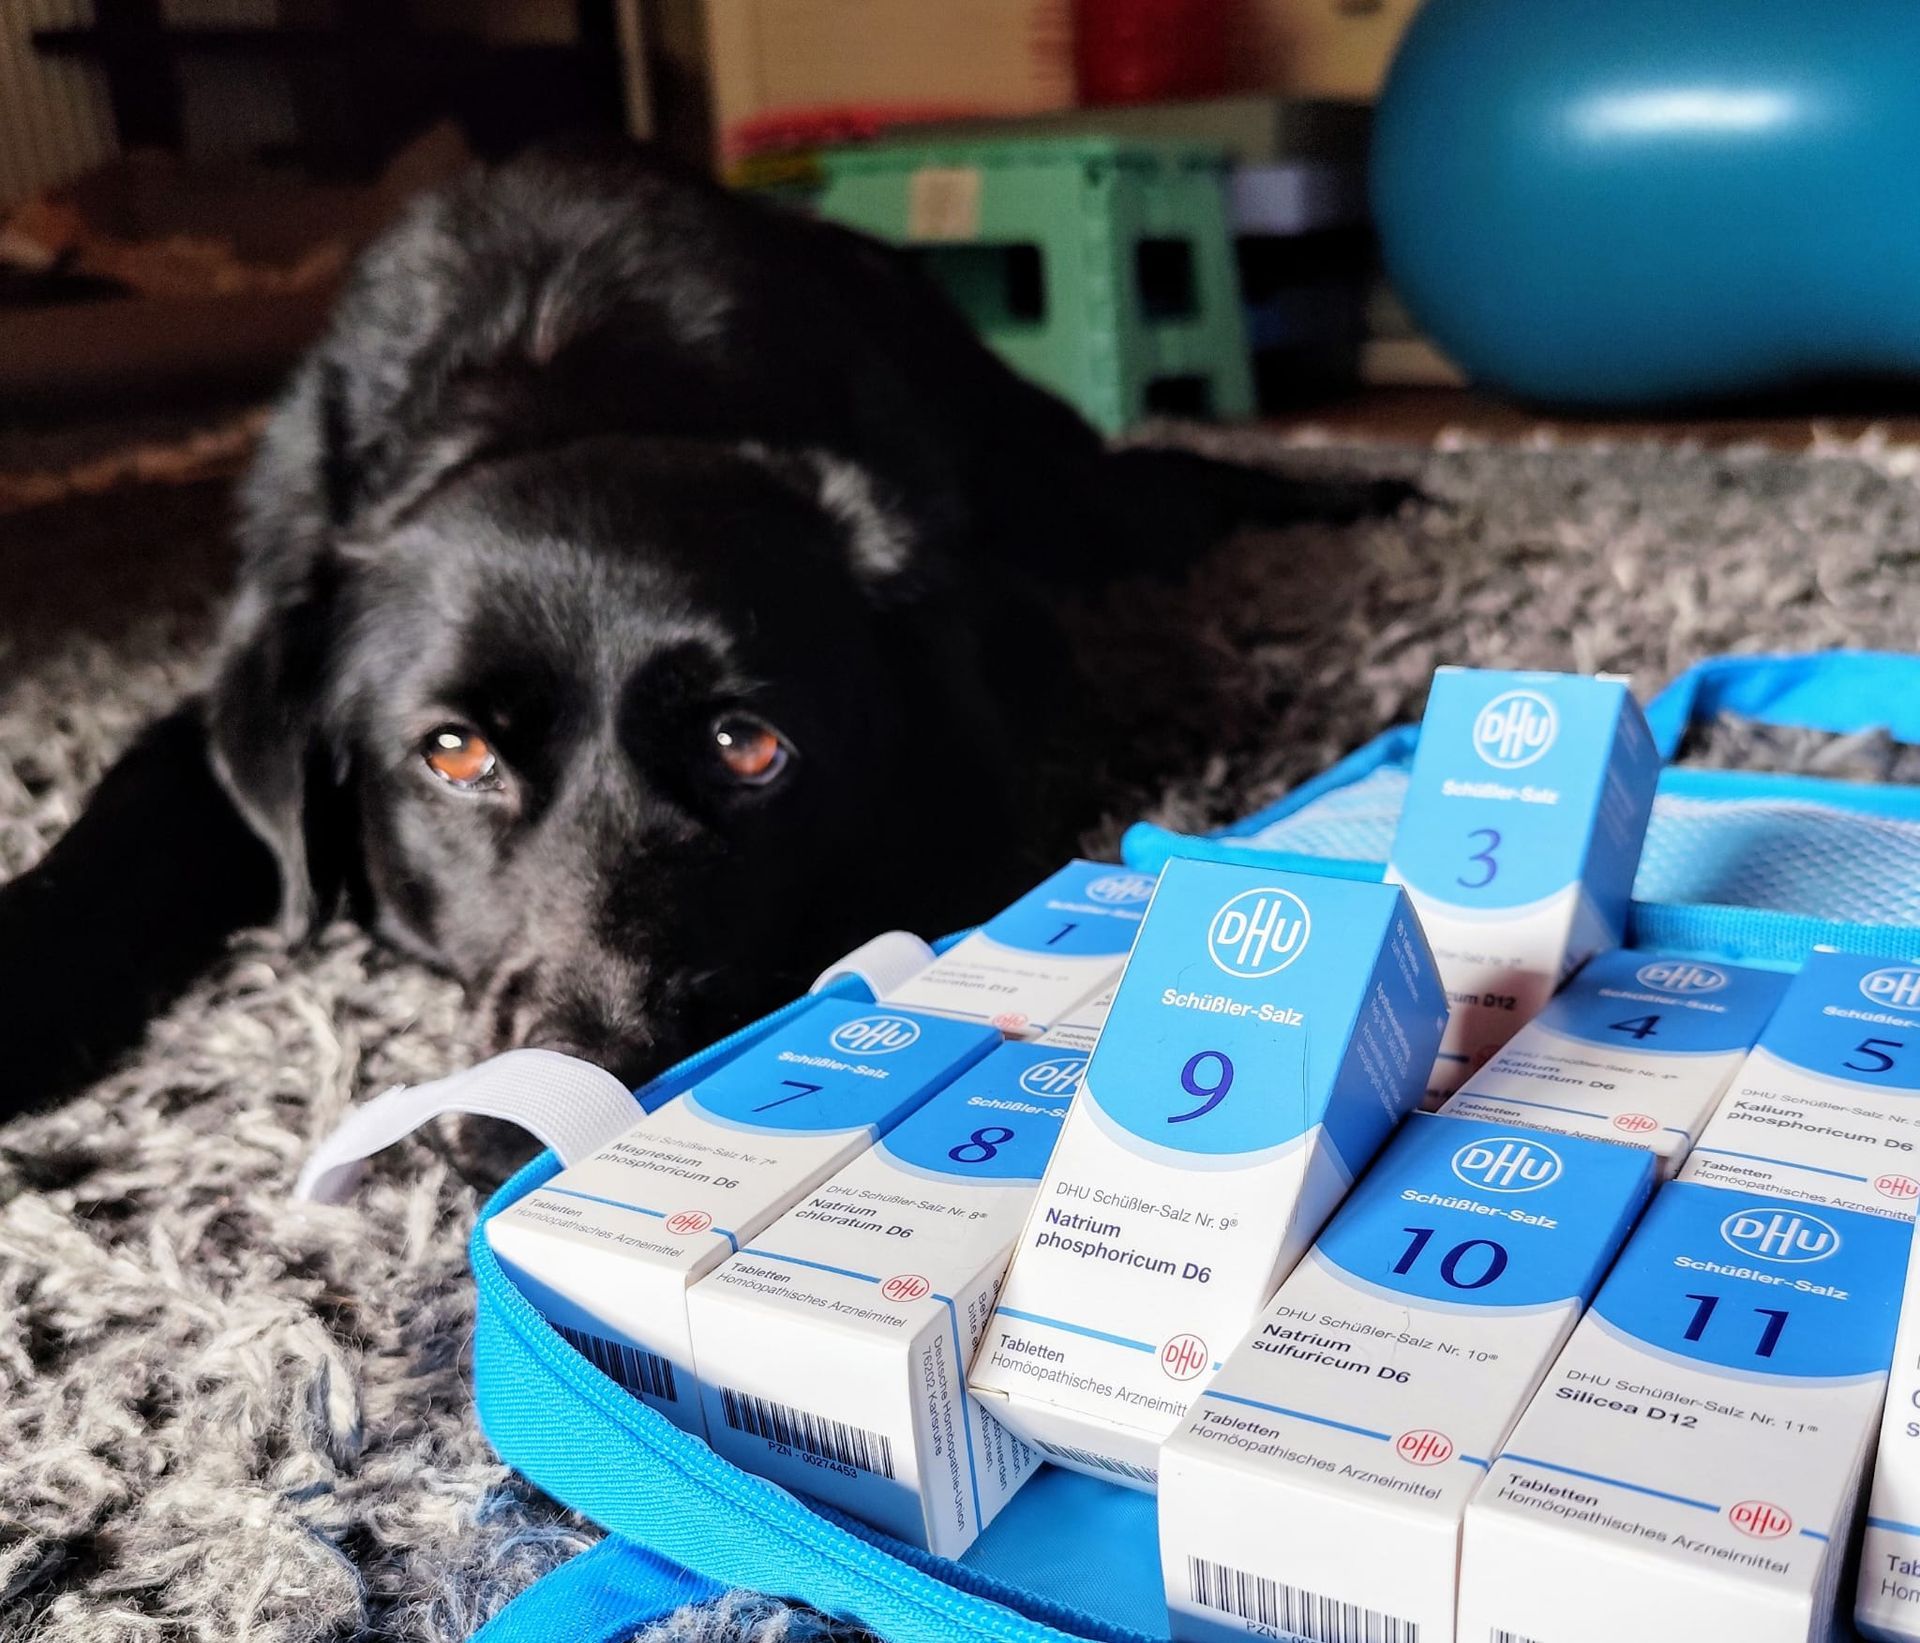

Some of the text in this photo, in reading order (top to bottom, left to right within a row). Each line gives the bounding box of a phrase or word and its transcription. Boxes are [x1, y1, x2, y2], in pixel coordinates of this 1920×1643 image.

[1481, 700, 1548, 759] DHU
[1456, 828, 1502, 889] 3
[1046, 922, 1080, 945] 1
[1216, 898, 1302, 967] DHU
[1647, 962, 1718, 990] DHU
[1868, 973, 1920, 1006] DH
[1161, 988, 1304, 1027] Schüßler-Salz
[1483, 993, 1517, 1011] D12
[839, 1020, 913, 1050] DHU
[1608, 1015, 1662, 1040] 4
[778, 1051, 890, 1079] Schüßler-Salz
[1498, 1058, 1561, 1073] Kalium
[1842, 1038, 1904, 1073] 5
[1028, 1062, 1084, 1093] DH
[1167, 1050, 1234, 1123] 9
[1491, 1066, 1616, 1091] chloratum D6
[751, 1080, 824, 1112] 7
[1457, 1101, 1521, 1117] Tabletten
[1734, 1100, 1804, 1119] Kalium
[1741, 1088, 1776, 1099] DHU
[1780, 1093, 1884, 1120] Schüßler-Salz
[1888, 1114, 1909, 1124] Nr.
[1617, 1115, 1654, 1131] DHU
[1727, 1110, 1913, 1152] phosphoricum D6
[612, 1142, 703, 1168] Magnesium
[948, 1126, 1015, 1163] 8
[594, 1150, 740, 1190] phosphoricum D6
[1461, 1143, 1552, 1186] DHU
[1701, 1160, 1773, 1181] Tabletten
[826, 1184, 859, 1196] DHU
[859, 1189, 946, 1214] Schüßler-Salz
[947, 1207, 965, 1218] Nr.
[1693, 1169, 1916, 1222] Homöopathisches Arzneimitte
[1878, 1177, 1918, 1197] DHU
[529, 1198, 583, 1218] Tabletten
[809, 1198, 877, 1217] Natrium
[1056, 1181, 1090, 1200] DHU
[1093, 1189, 1192, 1224] Schüßler-Salz
[1195, 1212, 1214, 1229] Nr.
[1400, 1189, 1559, 1230] Schüßler-Salz
[513, 1206, 684, 1258] Homöopathisches Arzneimittel
[671, 1214, 706, 1233] DHU
[796, 1208, 915, 1239] chloratum D6
[1045, 1207, 1121, 1239] Natrium
[1731, 1214, 1828, 1256] DHU
[730, 1262, 791, 1283] Tabletten
[1035, 1230, 1212, 1284] phosphoricum D6
[1392, 1227, 1509, 1289] 10
[887, 1278, 925, 1300] DHU
[1673, 1255, 1849, 1300] Schüßler-Salz
[716, 1272, 908, 1328] Homöopathisches Arzneimittel
[1262, 1323, 1352, 1353] Natrium
[1275, 1306, 1316, 1322] DHU
[1319, 1315, 1434, 1350] Schüßler-Salz
[1437, 1342, 1460, 1357] Nr.
[1683, 1293, 1789, 1358] 11
[1000, 1333, 1065, 1363] Tabletten
[1165, 1338, 1204, 1375] DHU
[1251, 1338, 1412, 1385] sulfuricum D6
[921, 1346, 944, 1457] 76202 Karlsruhe
[991, 1351, 1188, 1418] Homöopathisches Arzneimitt
[1566, 1369, 1611, 1386] DHU
[1616, 1379, 1744, 1419] Schüßler-Salz
[1750, 1411, 1775, 1427] Nr.
[1201, 1409, 1280, 1440] Tabletten
[1555, 1386, 1699, 1430] Silicea D12
[933, 1335, 966, 1532] Deutsche Homöopathie-Union
[1401, 1433, 1449, 1462] DHU
[768, 1441, 792, 1458] PZN
[802, 1451, 859, 1479] 00274453
[1188, 1424, 1443, 1501] Homöopathisches Arzneimittel
[1508, 1472, 1599, 1507] Tabletten
[1497, 1487, 1791, 1575] Homöopathisches Arzneimittel
[1734, 1505, 1787, 1534] DHU
[1246, 1620, 1278, 1639] PZN
